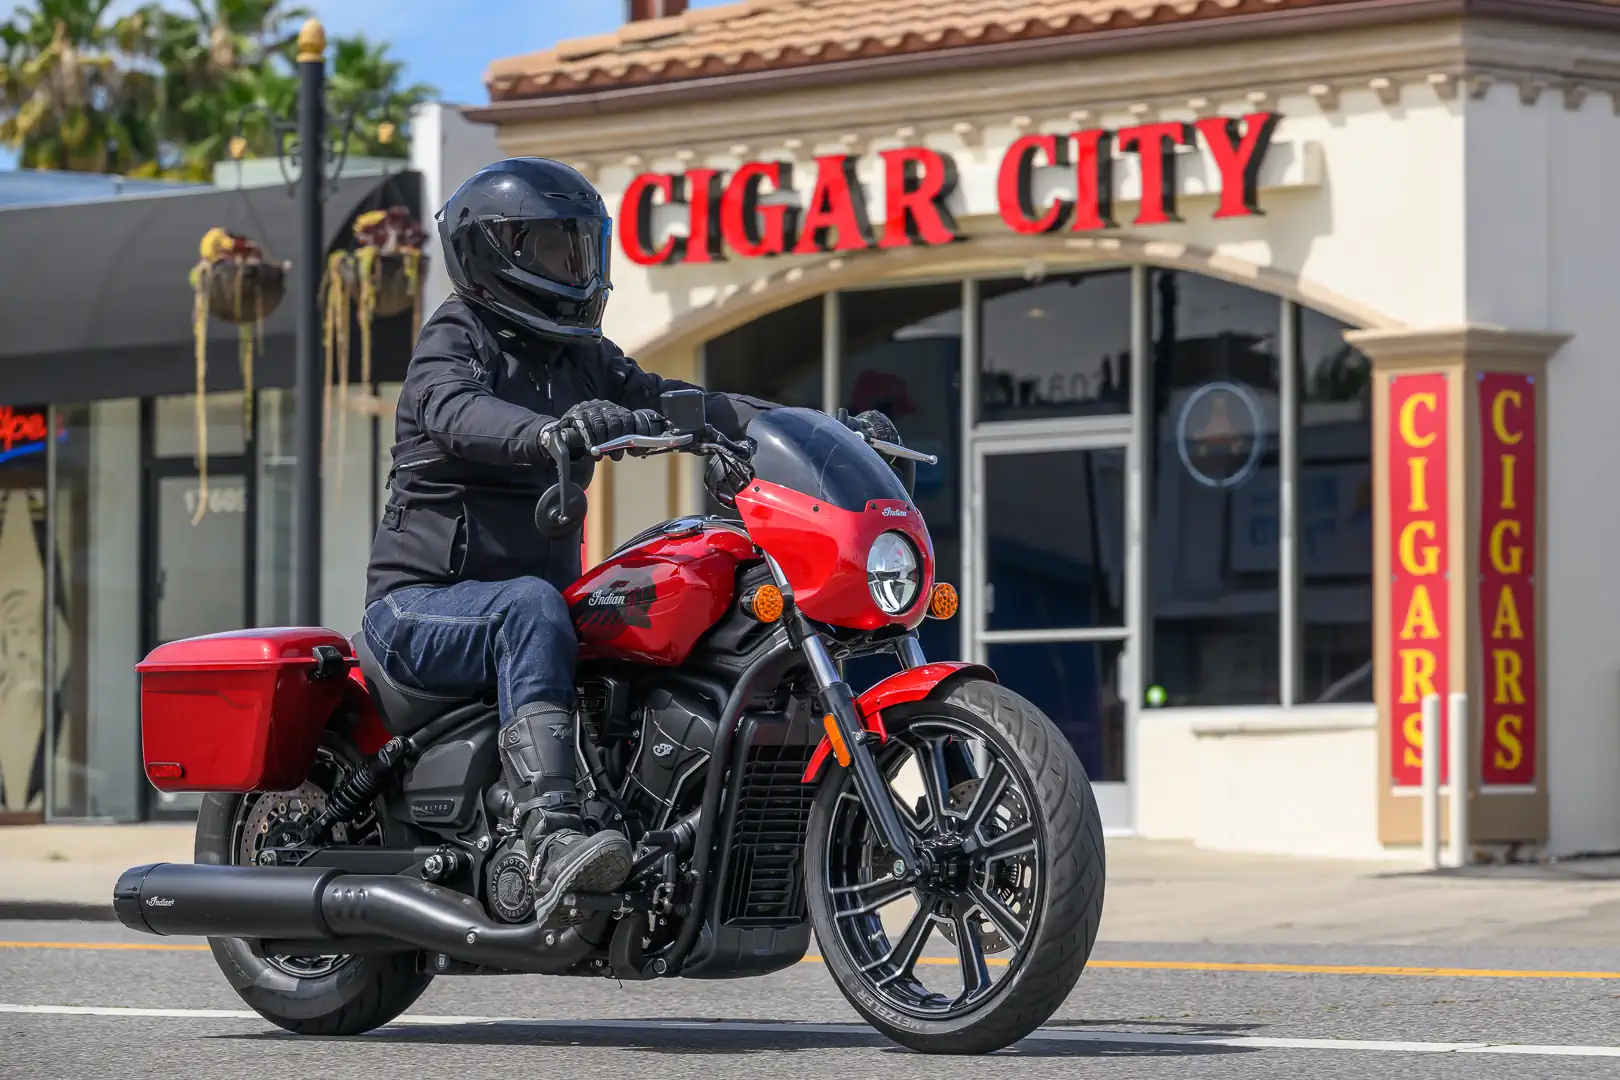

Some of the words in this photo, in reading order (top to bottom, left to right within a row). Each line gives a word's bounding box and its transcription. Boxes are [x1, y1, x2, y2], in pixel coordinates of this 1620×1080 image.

[619, 149, 958, 266] CIGAR
[997, 112, 1275, 235] CITY
[881, 507, 907, 517] Indian
[588, 589, 626, 606] Indian
[1398, 391, 1441, 768] CIGARS
[1488, 388, 1525, 770] CIGARS
[147, 896, 174, 907] Indian
[492, 866, 502, 905] INDIAN
[856, 989, 923, 1030] METZELER
